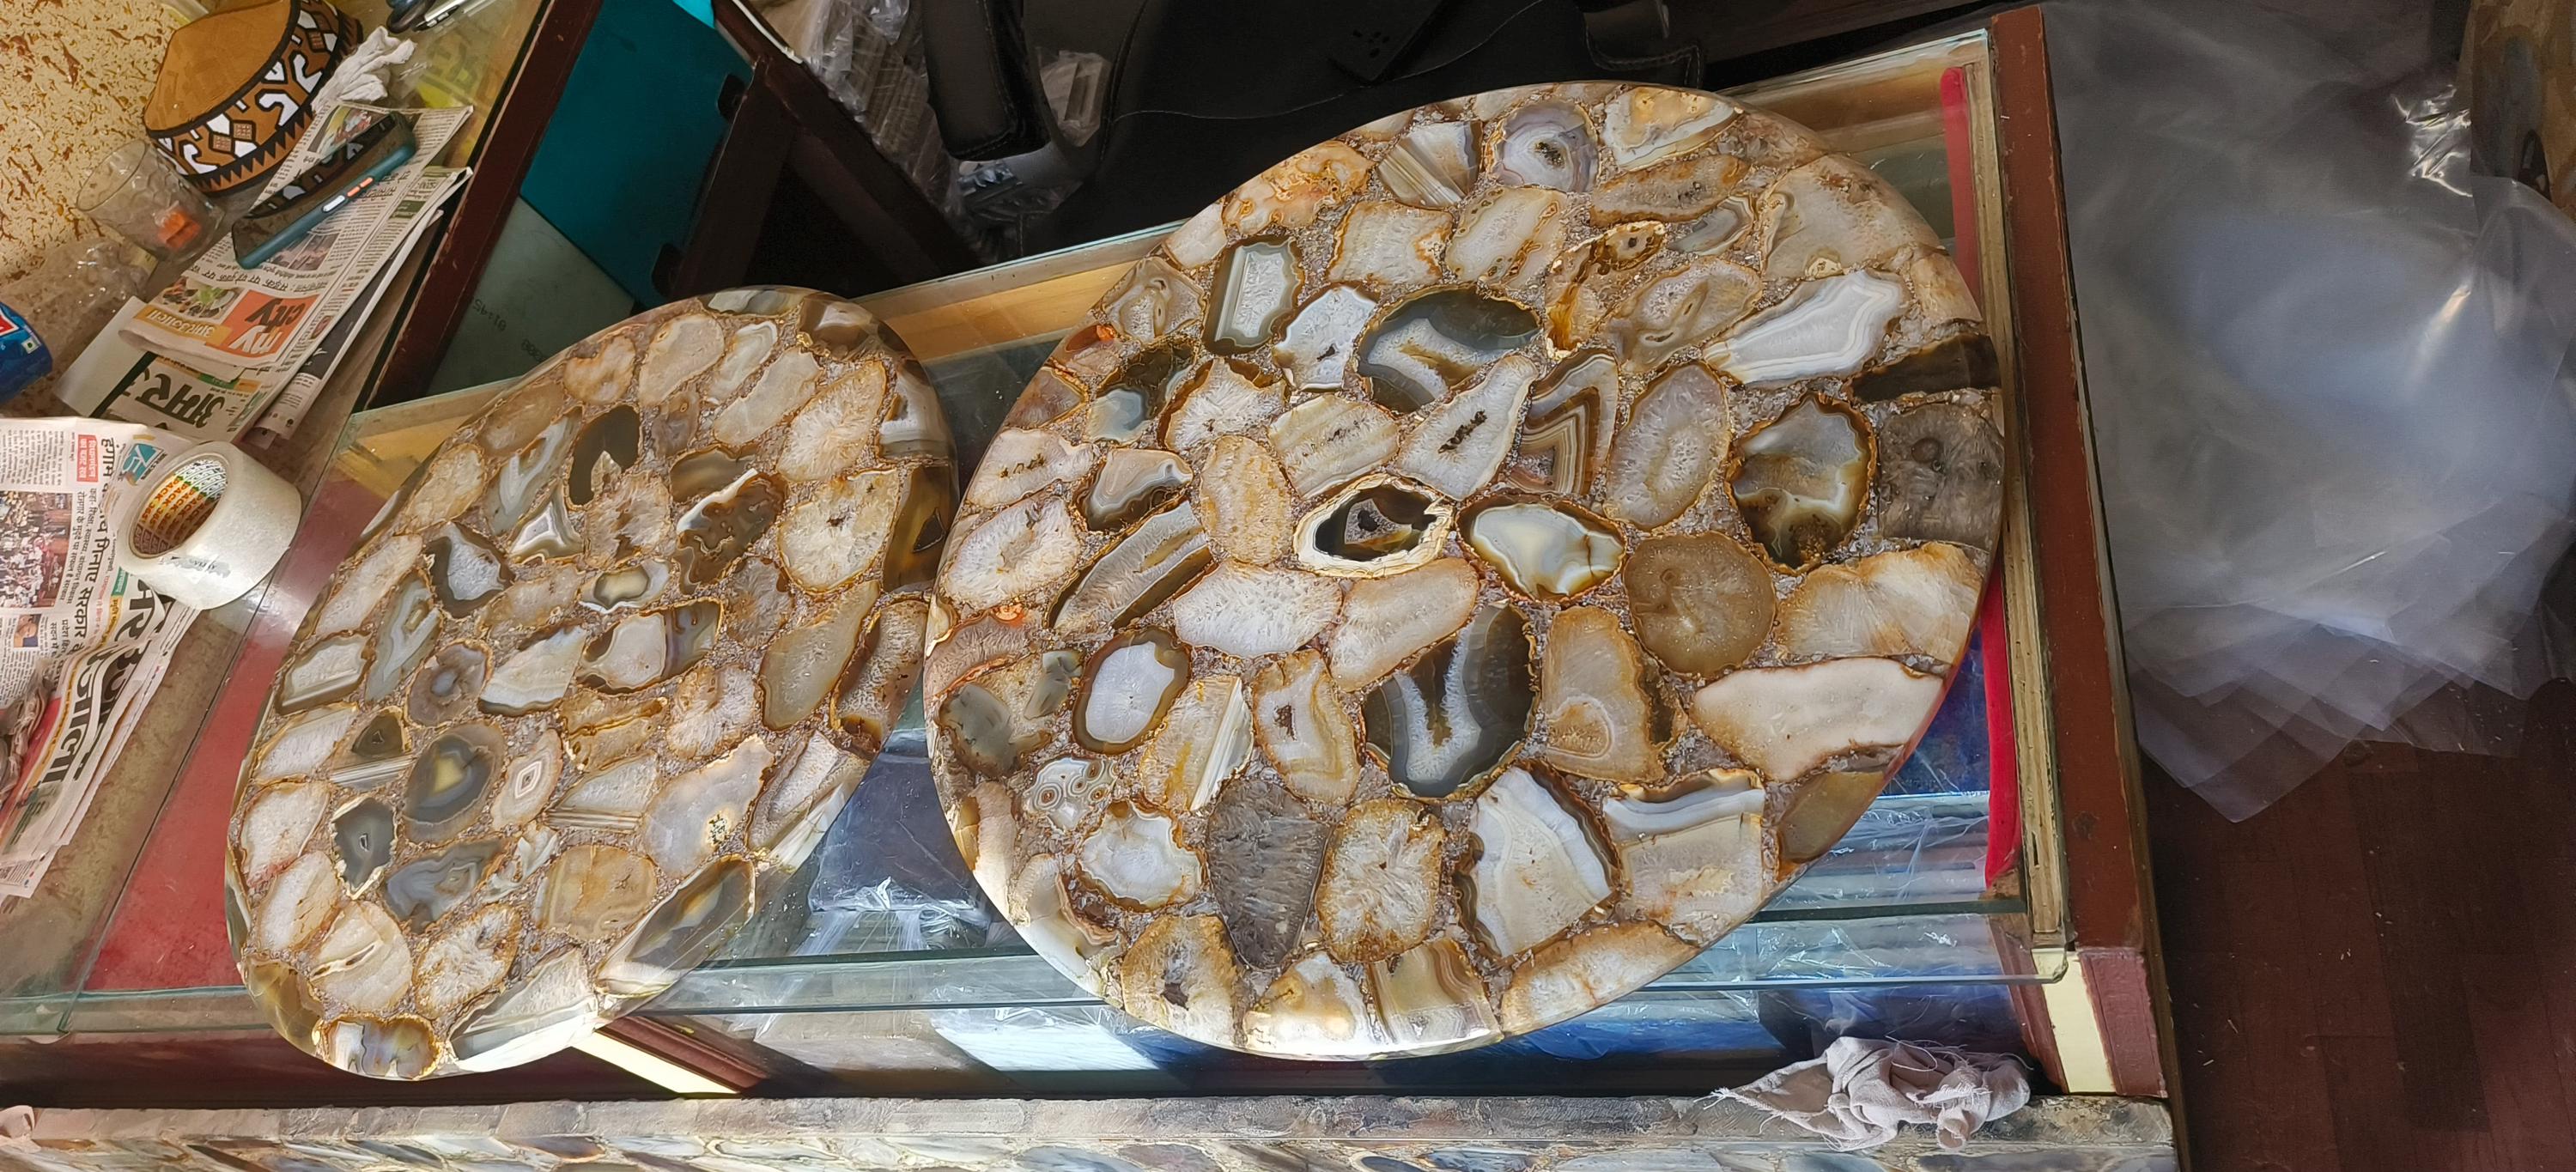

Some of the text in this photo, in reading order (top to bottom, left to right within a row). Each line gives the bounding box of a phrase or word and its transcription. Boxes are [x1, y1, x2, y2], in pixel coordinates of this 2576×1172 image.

[244, 297, 306, 333] city
[228, 325, 283, 355] my
[135, 373, 226, 428] अमर
[84, 537, 111, 583] गिनाए
[74, 586, 94, 639] सरकार
